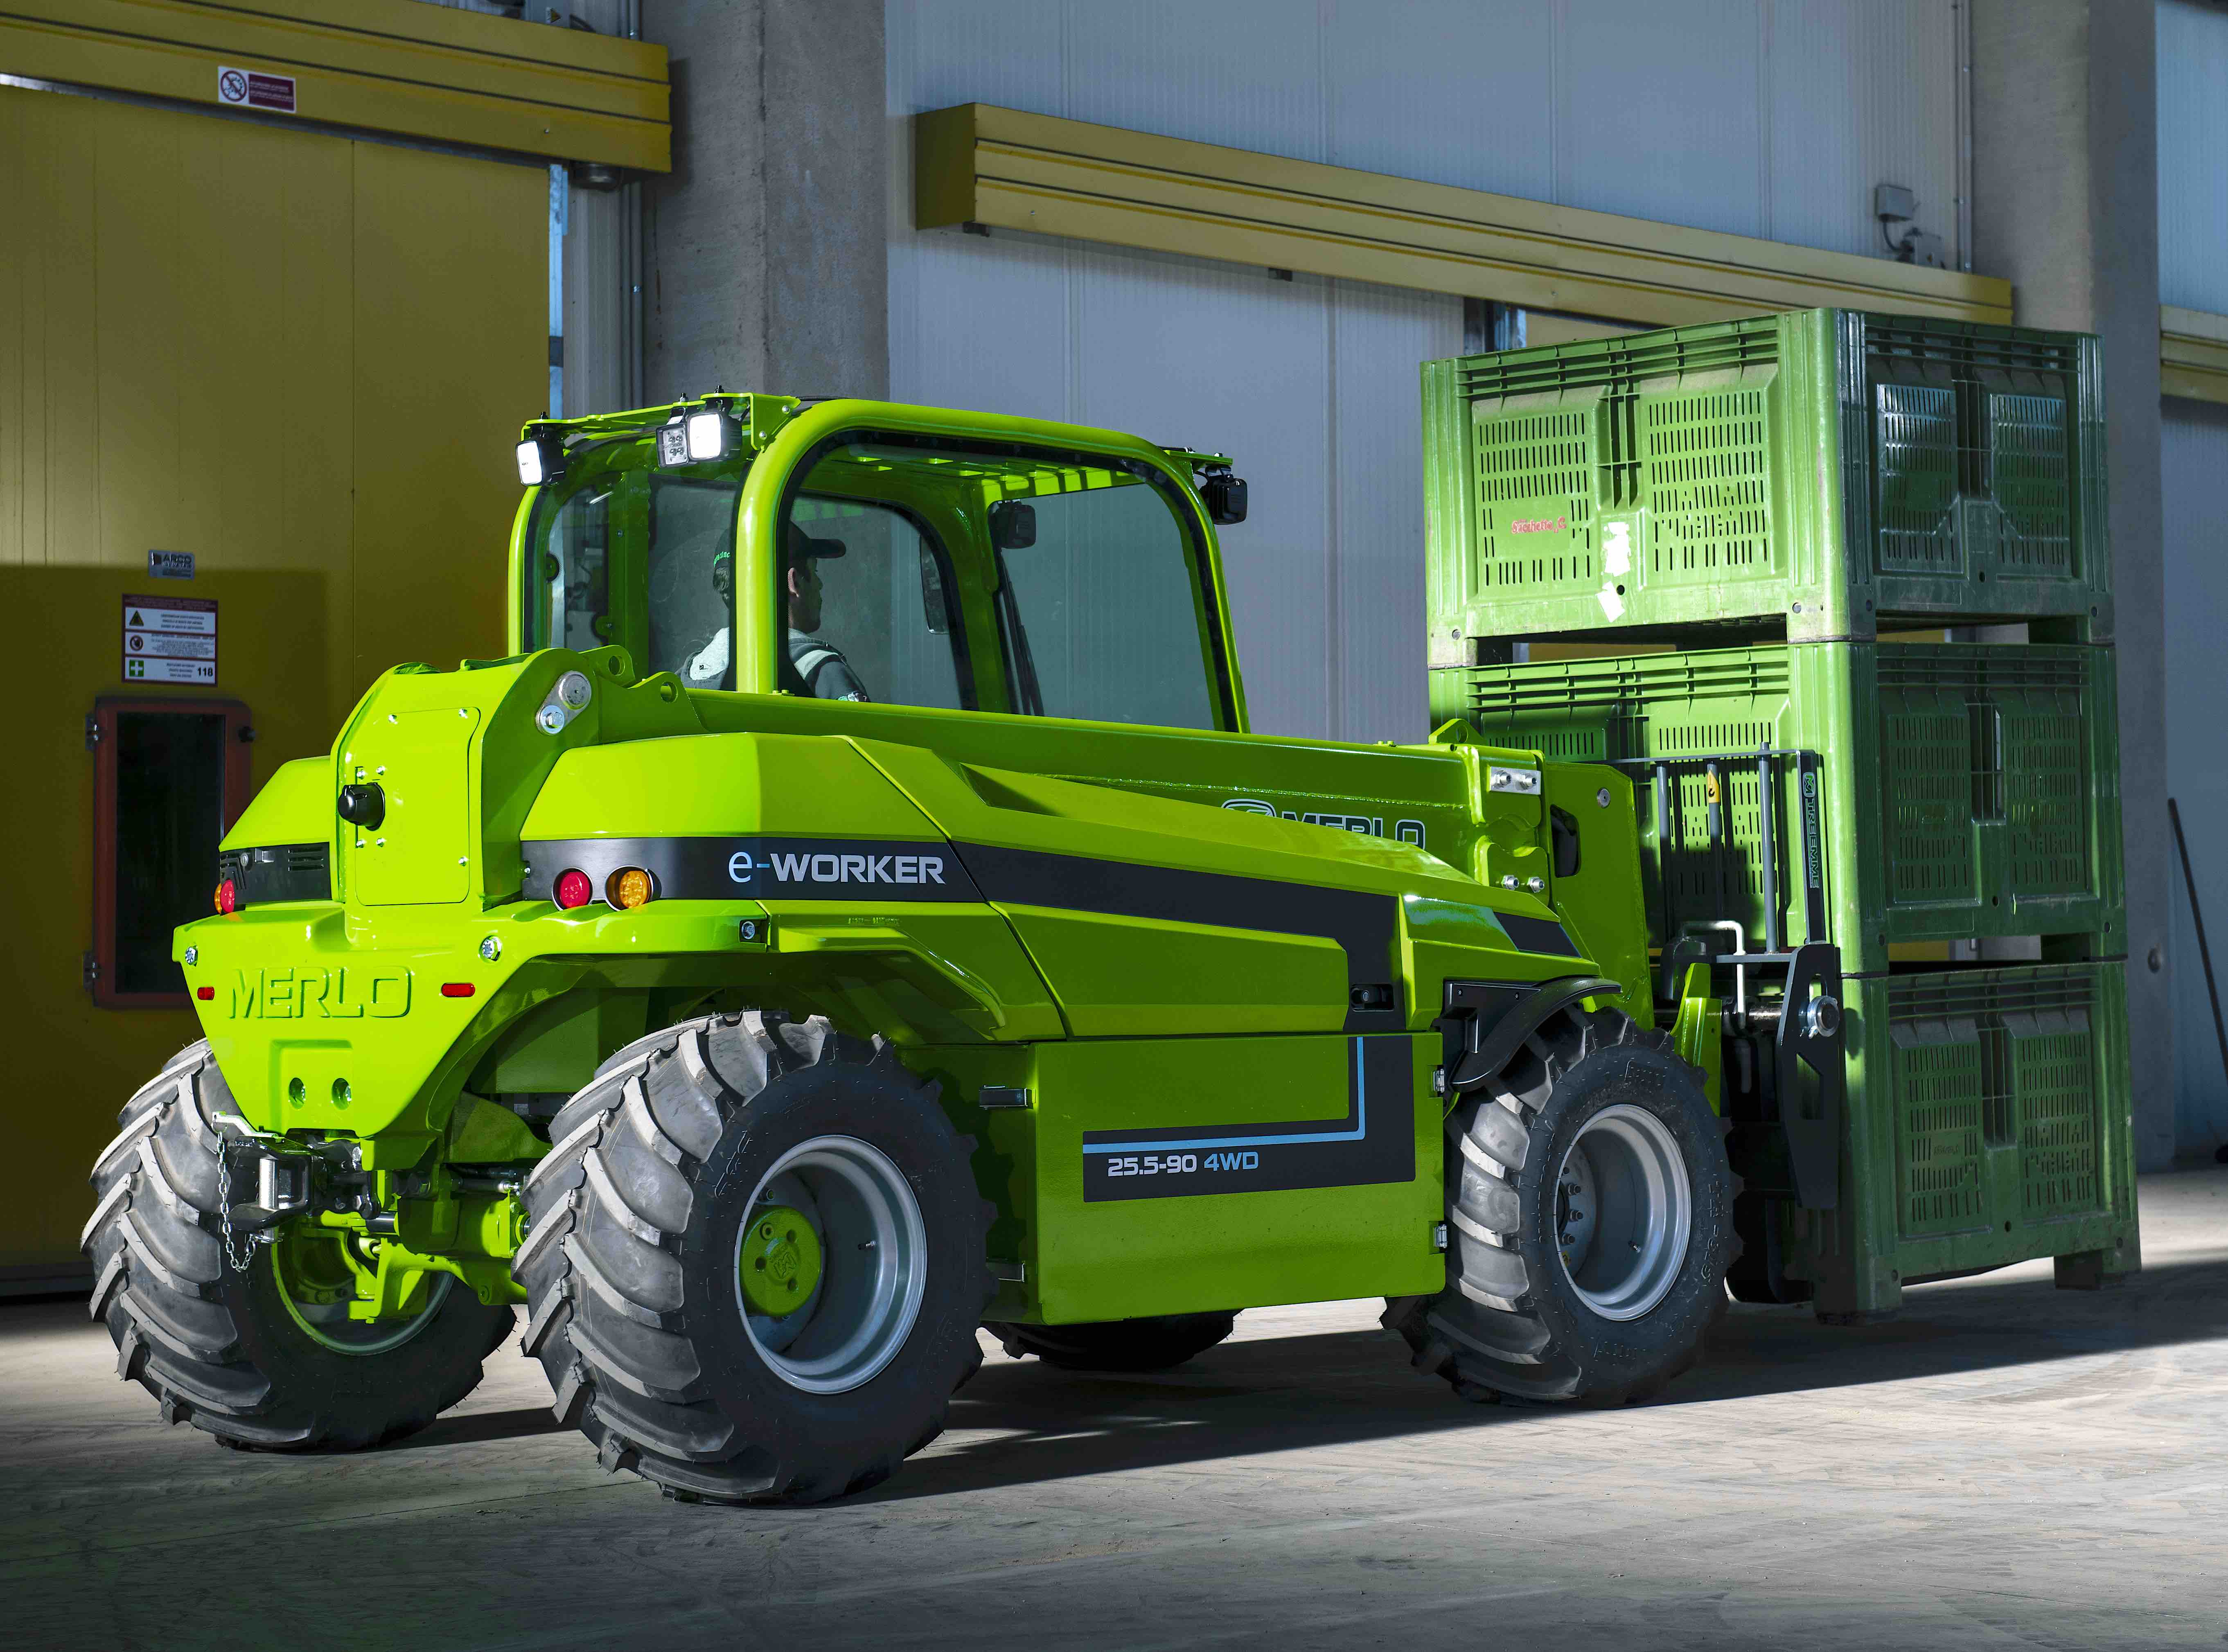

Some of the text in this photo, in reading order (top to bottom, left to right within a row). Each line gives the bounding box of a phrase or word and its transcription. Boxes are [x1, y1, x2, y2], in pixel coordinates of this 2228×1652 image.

[197, 667, 213, 677] 118
[728, 851, 945, 884] e-WORKER
[228, 966, 413, 1019] MERLO
[1107, 1151, 1258, 1177] 25.5-90 4WD
